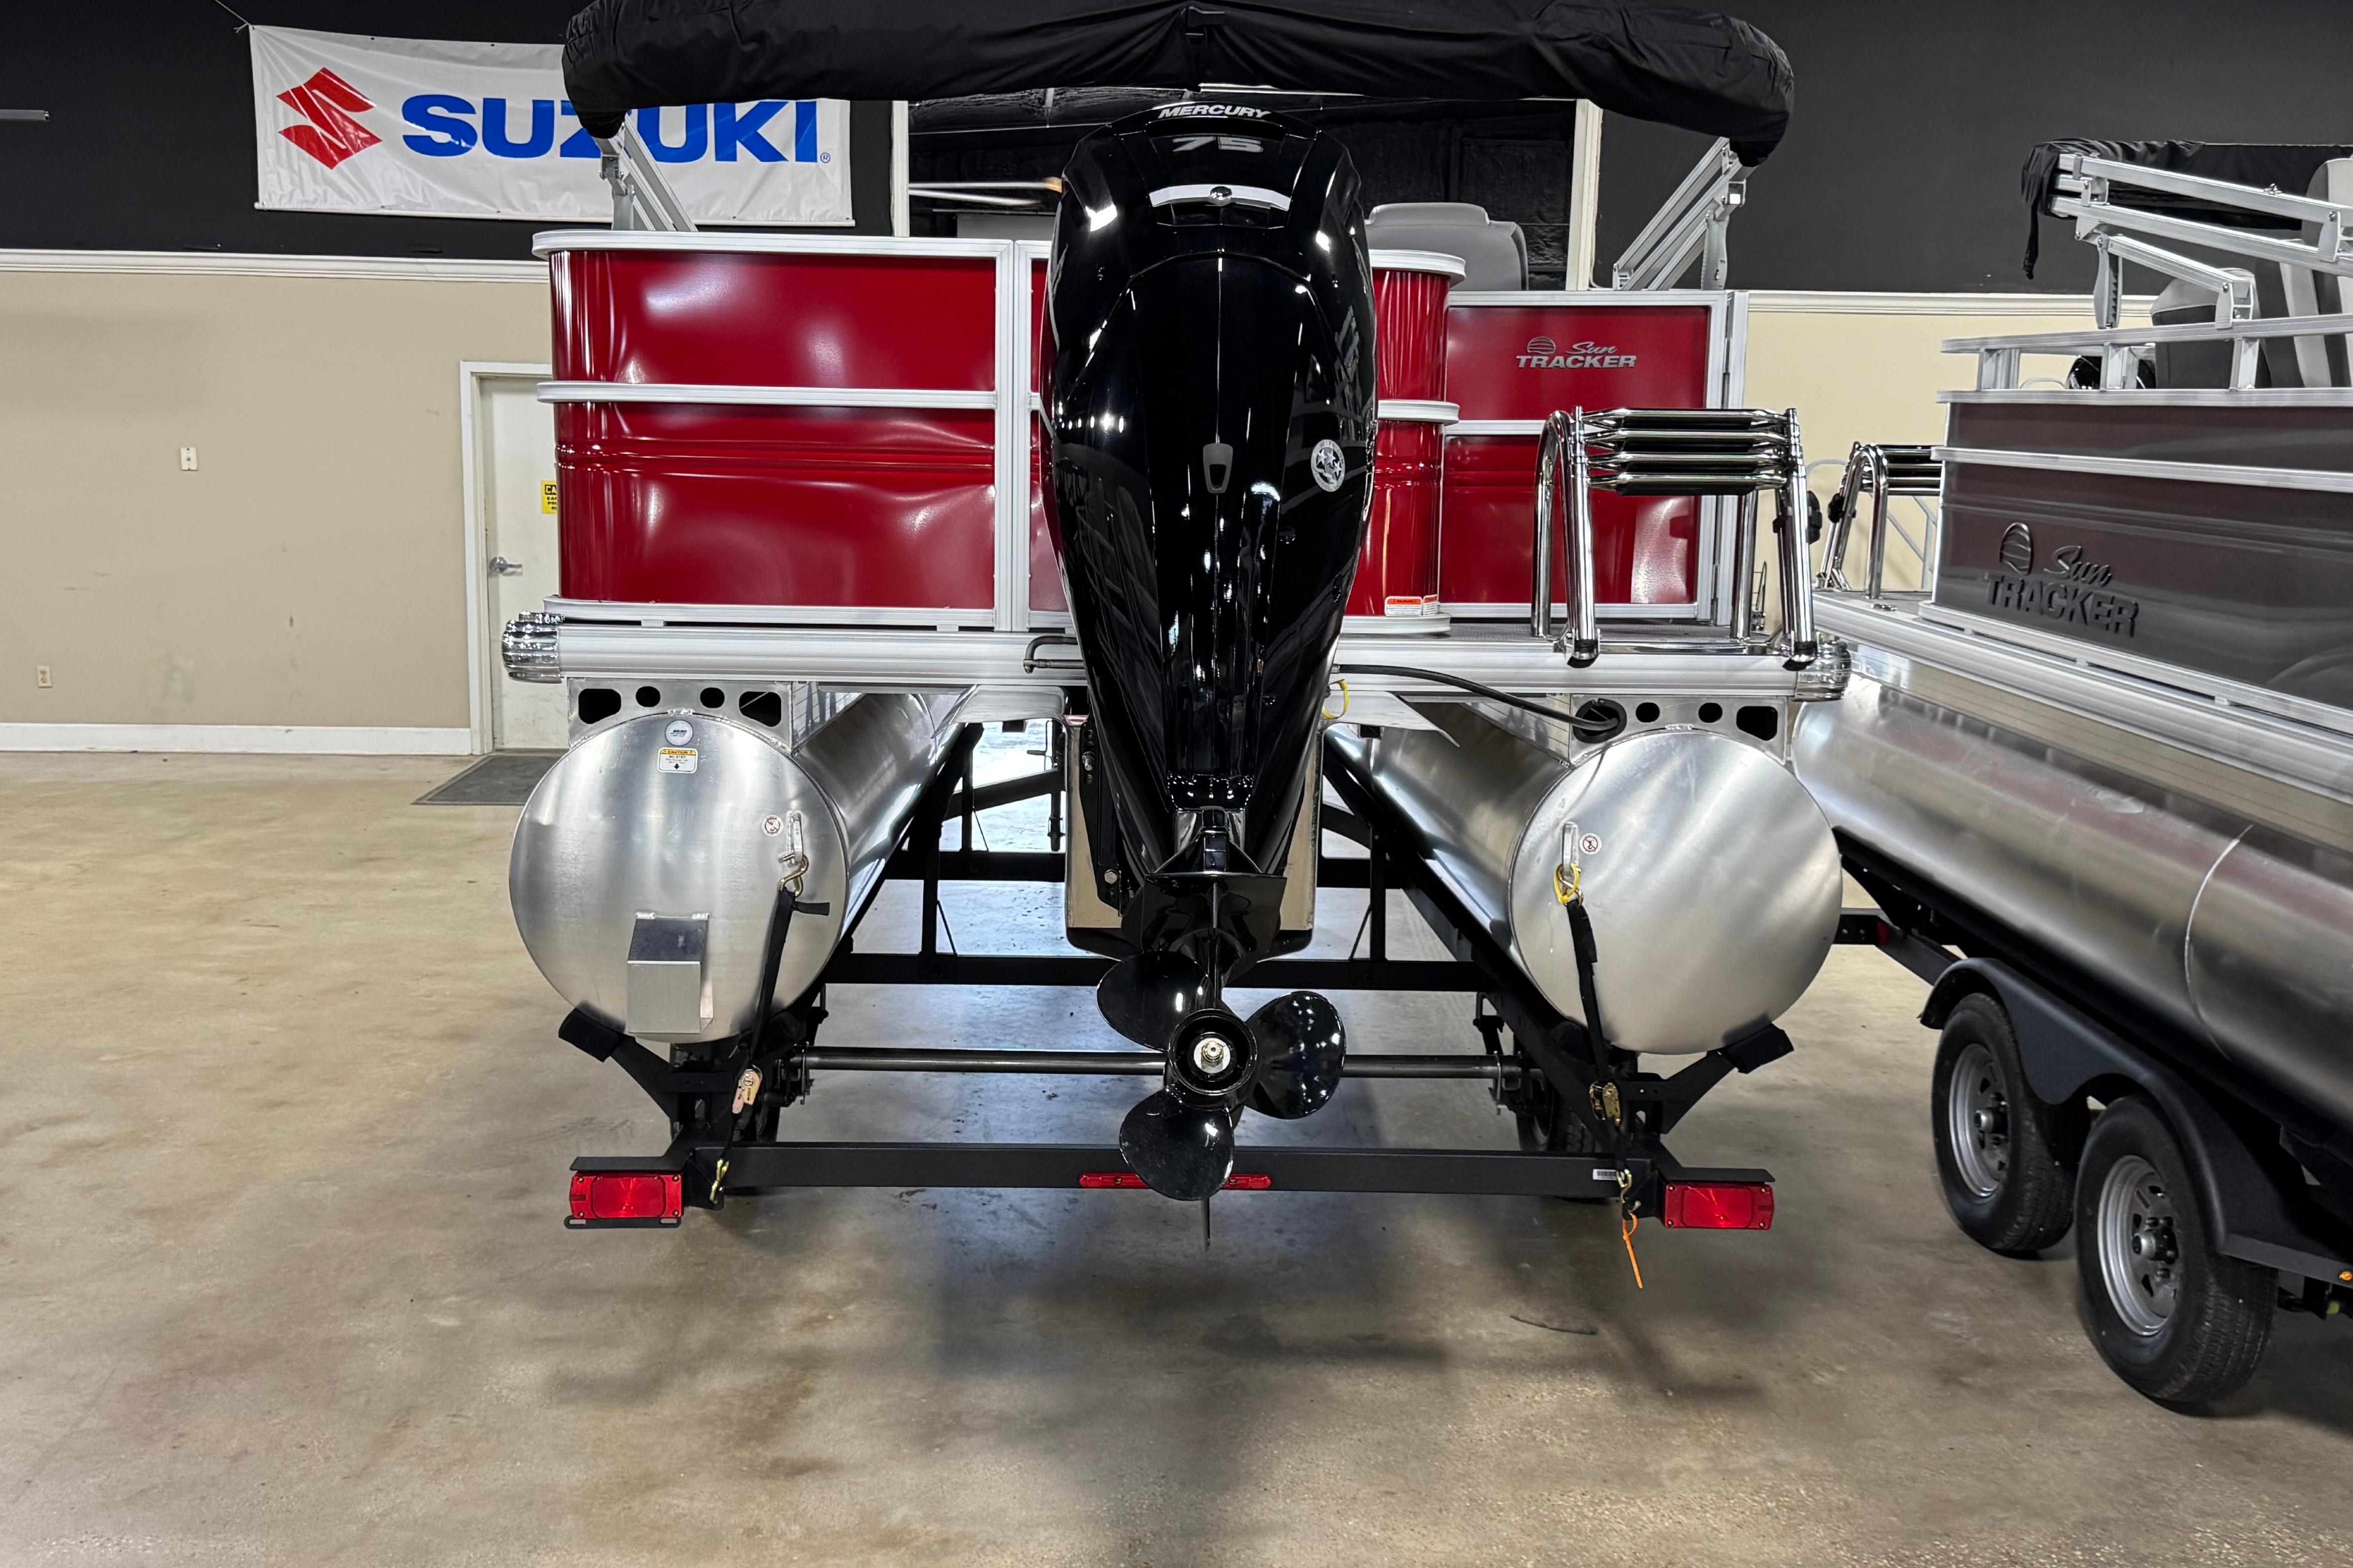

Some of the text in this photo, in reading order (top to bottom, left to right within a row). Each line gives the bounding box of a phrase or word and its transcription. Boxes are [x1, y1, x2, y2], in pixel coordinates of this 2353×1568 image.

[1157, 104, 1272, 119] MERCURY
[1172, 136, 1263, 153] 75
[1566, 341, 1617, 355] Sun
[1516, 355, 1637, 369] TRACKER
[2043, 545, 2113, 588] Sun
[1989, 575, 2139, 638] TRACKER
